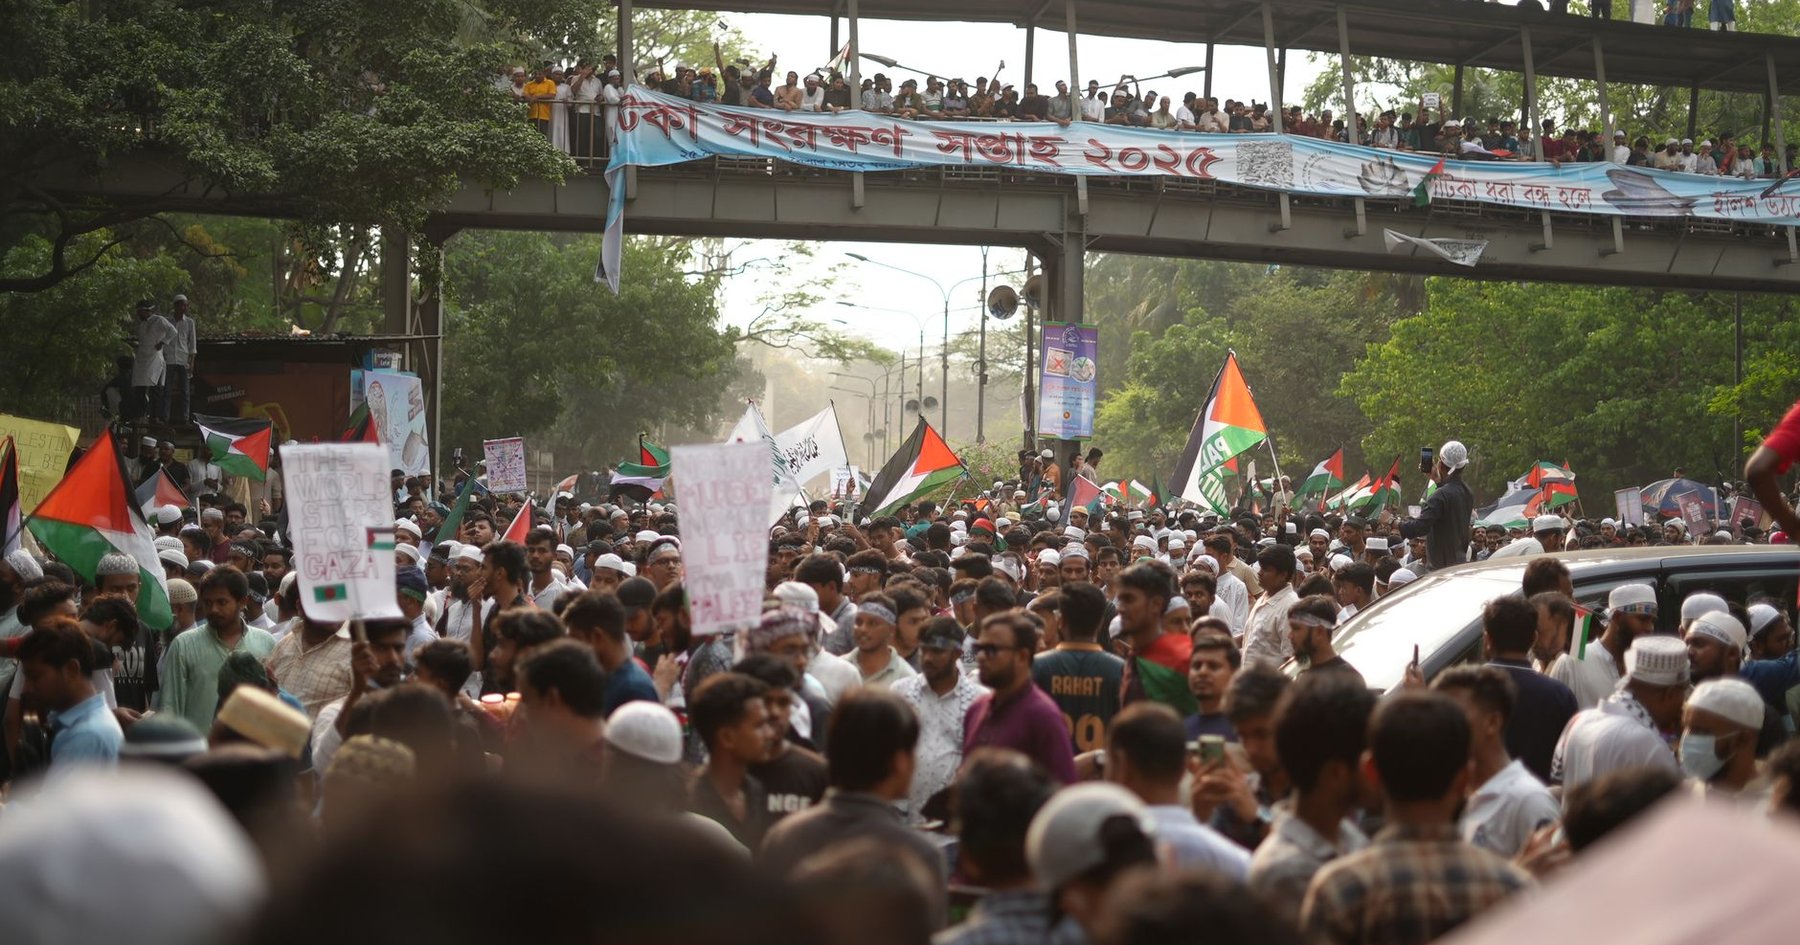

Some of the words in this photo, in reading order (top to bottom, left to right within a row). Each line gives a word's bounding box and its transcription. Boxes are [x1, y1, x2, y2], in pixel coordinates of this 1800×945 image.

[719, 111, 914, 158] সংরক্ষণ
[931, 130, 1069, 168] সপ্তাহ
[1084, 138, 1223, 179] ২০২৫
[1486, 180, 1516, 204] ধরা
[1521, 183, 1551, 207] বন্ধ
[1555, 186, 1592, 210] হলে
[289, 450, 355, 473] THE
[293, 474, 390, 502] WORLD
[302, 501, 386, 529] STOPS
[301, 525, 361, 554] FOR
[303, 552, 379, 582] GAZA
[1051, 675, 1104, 696] RAHAT
